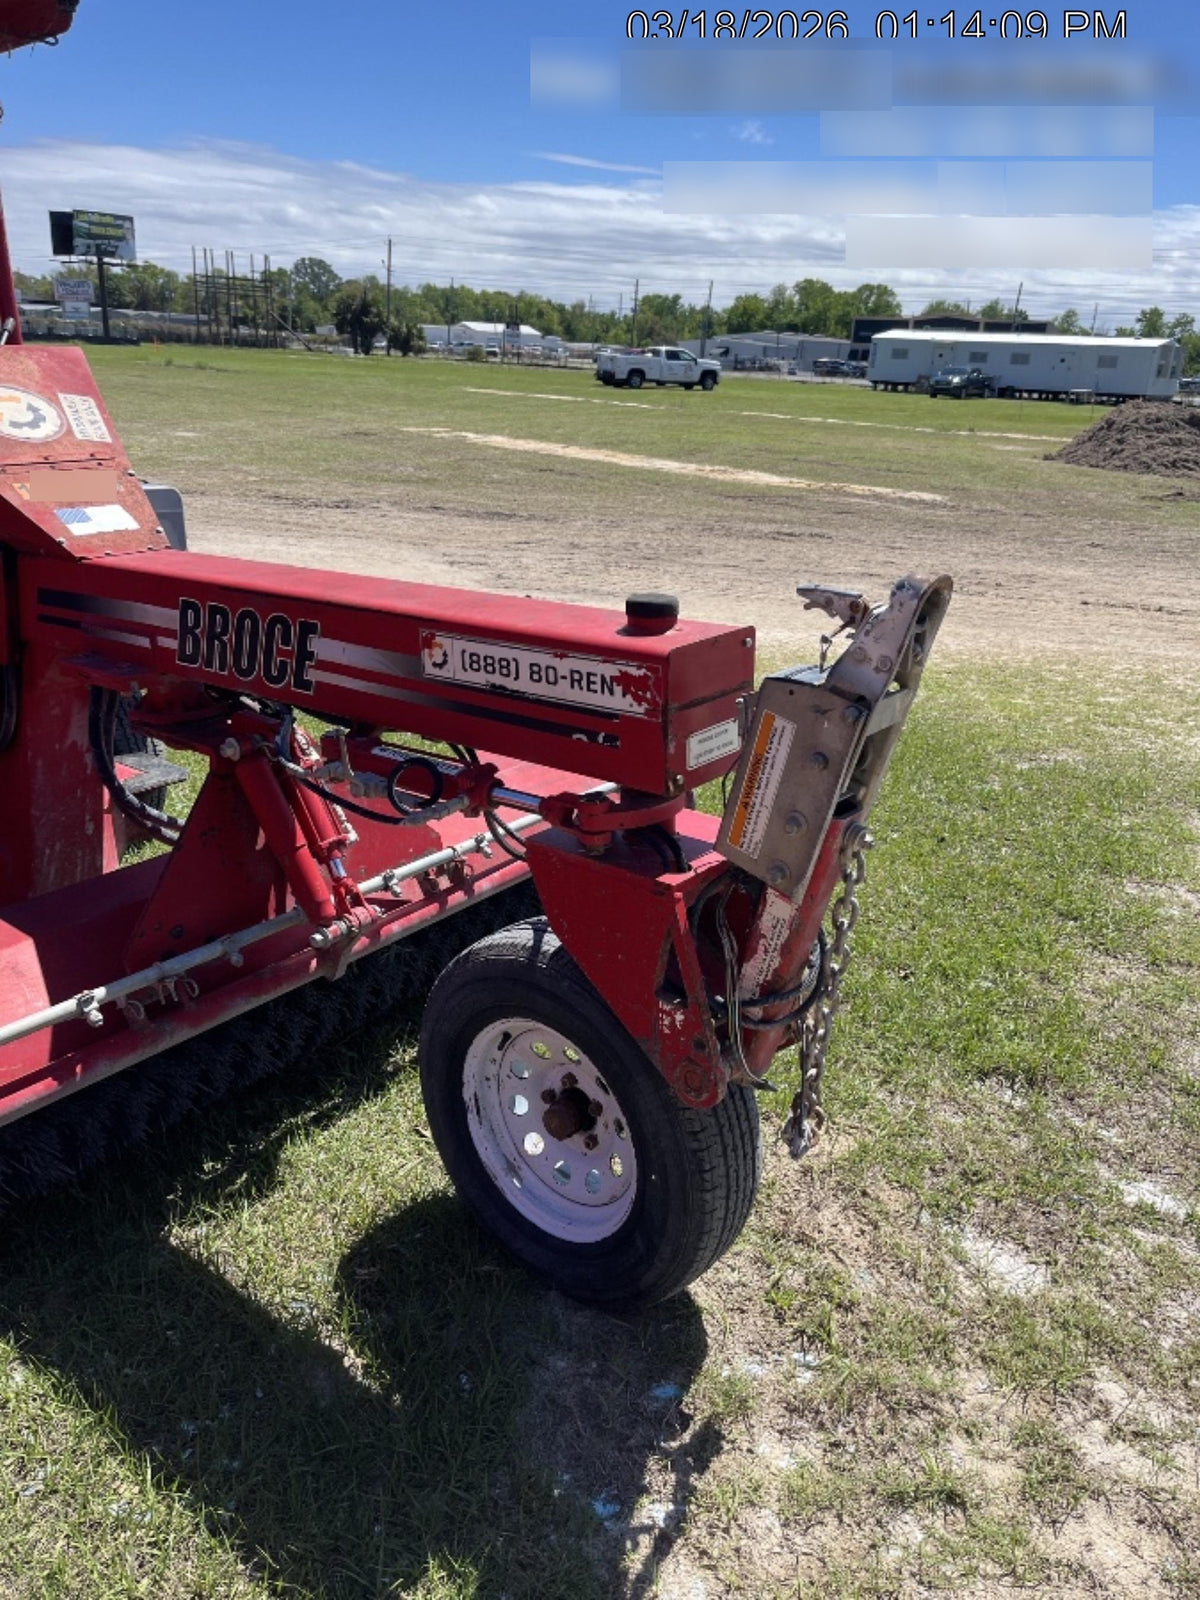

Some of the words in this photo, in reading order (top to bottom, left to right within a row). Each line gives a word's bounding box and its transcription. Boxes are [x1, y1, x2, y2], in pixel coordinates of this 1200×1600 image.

[176, 597, 320, 696] BROCE
[460, 648, 521, 682] (888)
[528, 662, 633, 699] 80-REN
